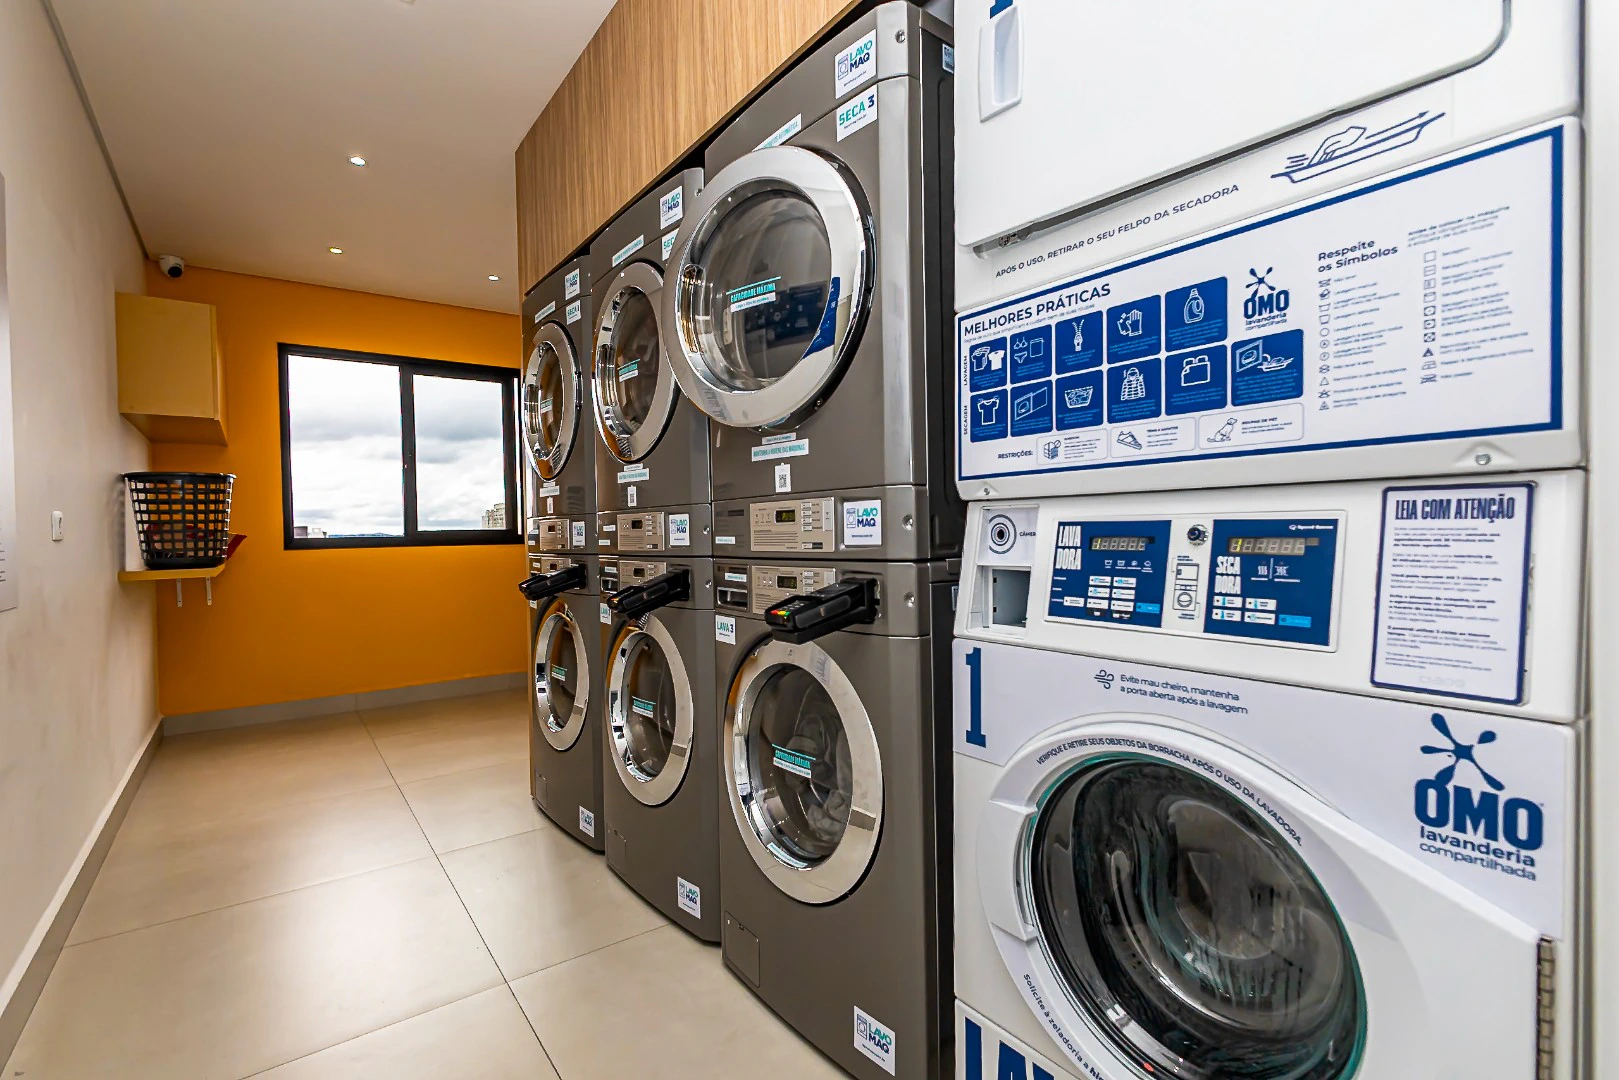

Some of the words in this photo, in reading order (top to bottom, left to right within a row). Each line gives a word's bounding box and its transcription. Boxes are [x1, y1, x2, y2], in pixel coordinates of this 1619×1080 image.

[850, 40, 872, 62] LAVO
[850, 52, 870, 72] MAQ
[839, 101, 866, 126] SECA
[868, 94, 875, 108] 3
[668, 193, 680, 204] LAVO
[668, 201, 680, 213] MAQ
[995, 265, 1018, 278] APÓS
[1018, 262, 1025, 270] O
[1026, 255, 1046, 269] USO,
[1047, 241, 1085, 259] RETIRAR
[1086, 237, 1095, 246] O
[1096, 229, 1116, 243] SEU
[1117, 216, 1152, 235] FELPO
[1153, 209, 1170, 222] DA
[1172, 184, 1240, 215] SECADORA
[663, 237, 675, 250] SEC
[1318, 240, 1376, 262] Respeite
[1318, 264, 1333, 273] os
[964, 306, 1033, 337] MELHORES
[1036, 283, 1111, 317] PRÁTICAS
[1244, 290, 1289, 319] OMO
[1246, 312, 1287, 325] lavanderia
[997, 450, 1034, 460] RESTRIÇÕES:
[857, 507, 878, 517] LAVO
[1395, 499, 1418, 520] LEIA
[1421, 498, 1451, 520] COM
[1454, 493, 1515, 523] ATENÇÃO
[857, 518, 876, 527] MAQ
[1058, 525, 1082, 547] LAVA
[1055, 548, 1082, 570] DORA
[1216, 556, 1241, 575] SECA
[1214, 575, 1241, 594] DORA
[717, 621, 730, 632] LAVA
[730, 624, 734, 633] 3
[966, 647, 986, 748] 1
[1120, 674, 1139, 684] Evite
[1141, 678, 1160, 688] mau
[1161, 680, 1190, 693] cheiro,
[1191, 686, 1240, 701] mantenha
[1126, 687, 1147, 696] porta
[1149, 690, 1176, 702] aberta
[1177, 695, 1198, 706] após
[1207, 699, 1248, 715] lavagem
[1036, 745, 1063, 765] VERIFIQUE
[1063, 743, 1068, 751] E
[1068, 738, 1088, 749] RETIRE
[1088, 737, 1105, 745] SEUS
[1106, 737, 1135, 748] OBJETOS
[1136, 740, 1147, 749] DA
[1148, 743, 1191, 763] BORRACHA
[1192, 757, 1215, 774] APÓS
[1215, 769, 1222, 778] O
[1224, 774, 1242, 790] USO
[1242, 787, 1255, 799] DA
[1256, 798, 1302, 846] LAVADORA.
[1414, 778, 1543, 851] OMO
[1420, 825, 1535, 867] lavanderia
[1420, 843, 1536, 881] compartilhada
[1023, 973, 1046, 1011] Solicite
[1044, 1010, 1050, 1018] à
[1049, 1017, 1082, 1062] zeladoria
[1083, 1061, 1089, 1069] a
[869, 1023, 892, 1046] LAVO
[869, 1033, 889, 1054] MAQ
